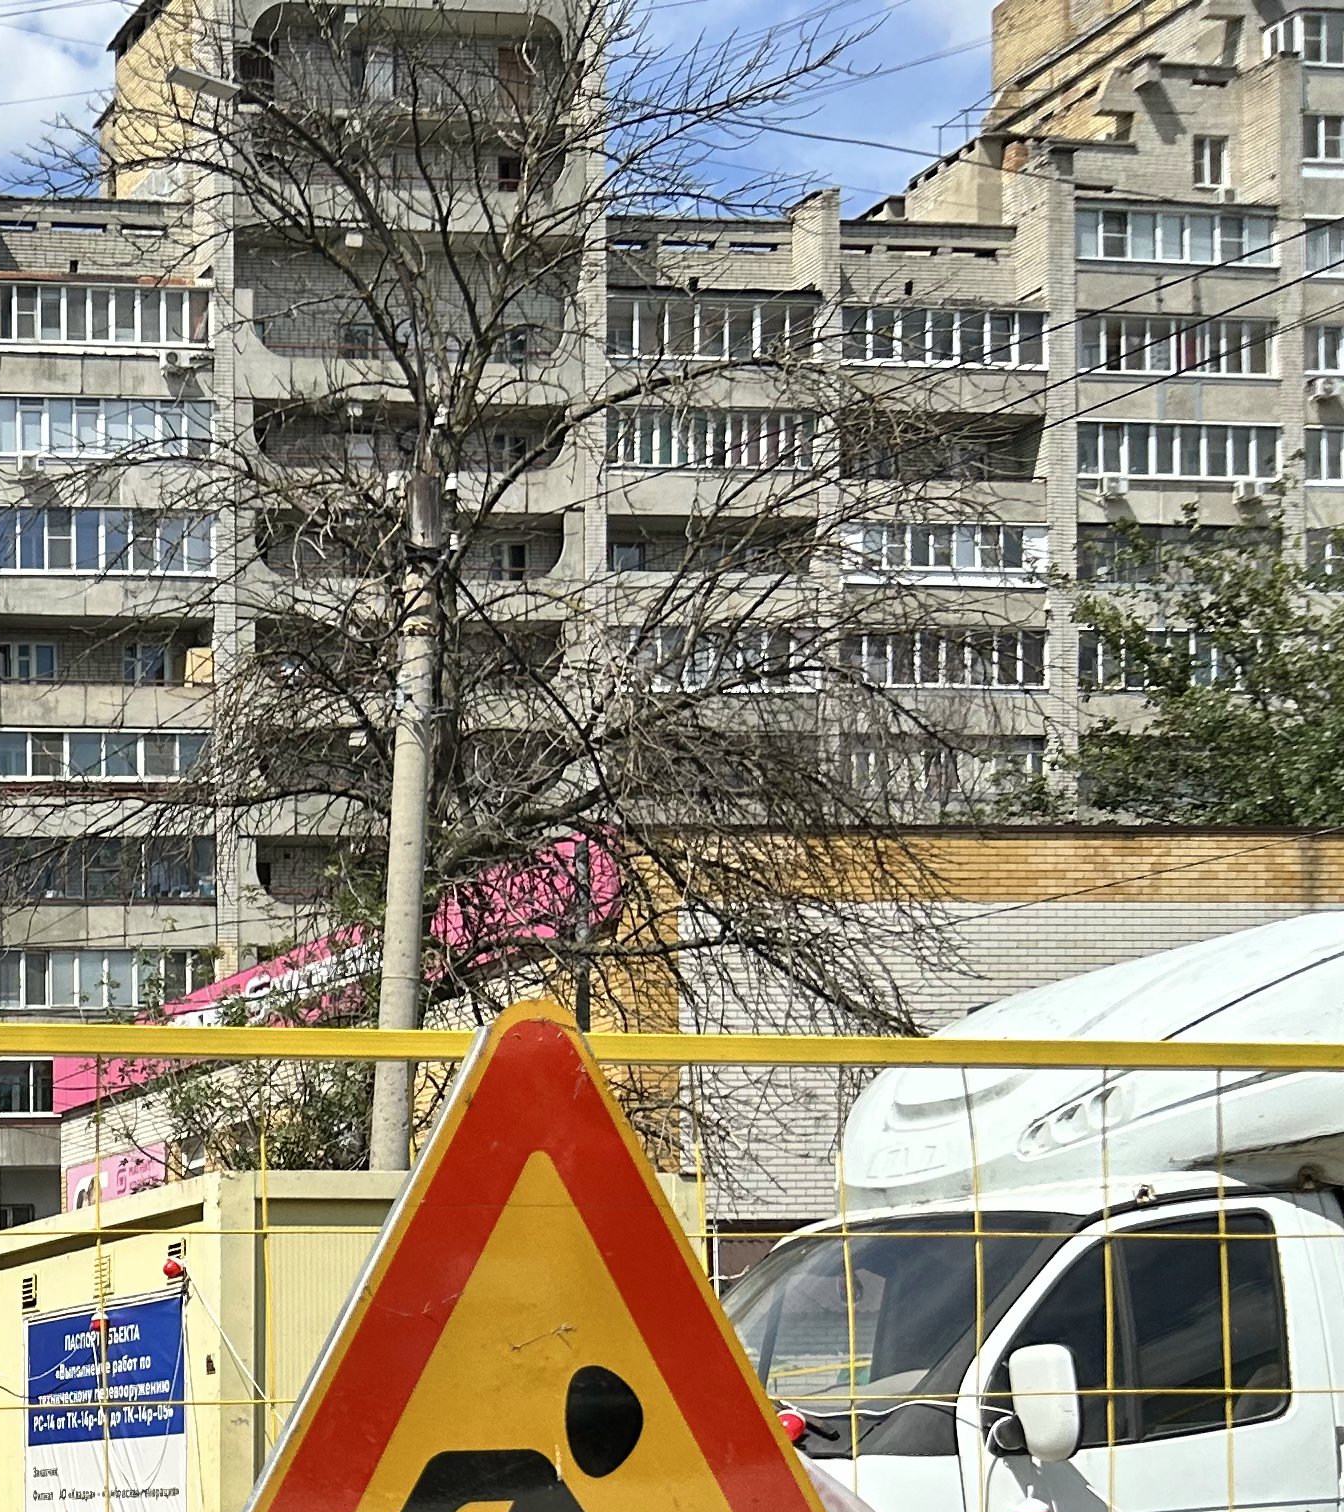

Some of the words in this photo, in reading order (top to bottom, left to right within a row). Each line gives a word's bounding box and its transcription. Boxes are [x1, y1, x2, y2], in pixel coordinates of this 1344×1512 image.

[105, 1324, 140, 1345] БЪЕКТА
[112, 1355, 138, 1377] работ
[139, 1356, 151, 1370] по
[33, 1414, 55, 1432] РС-14
[56, 1416, 66, 1430] от
[110, 1411, 121, 1427] до
